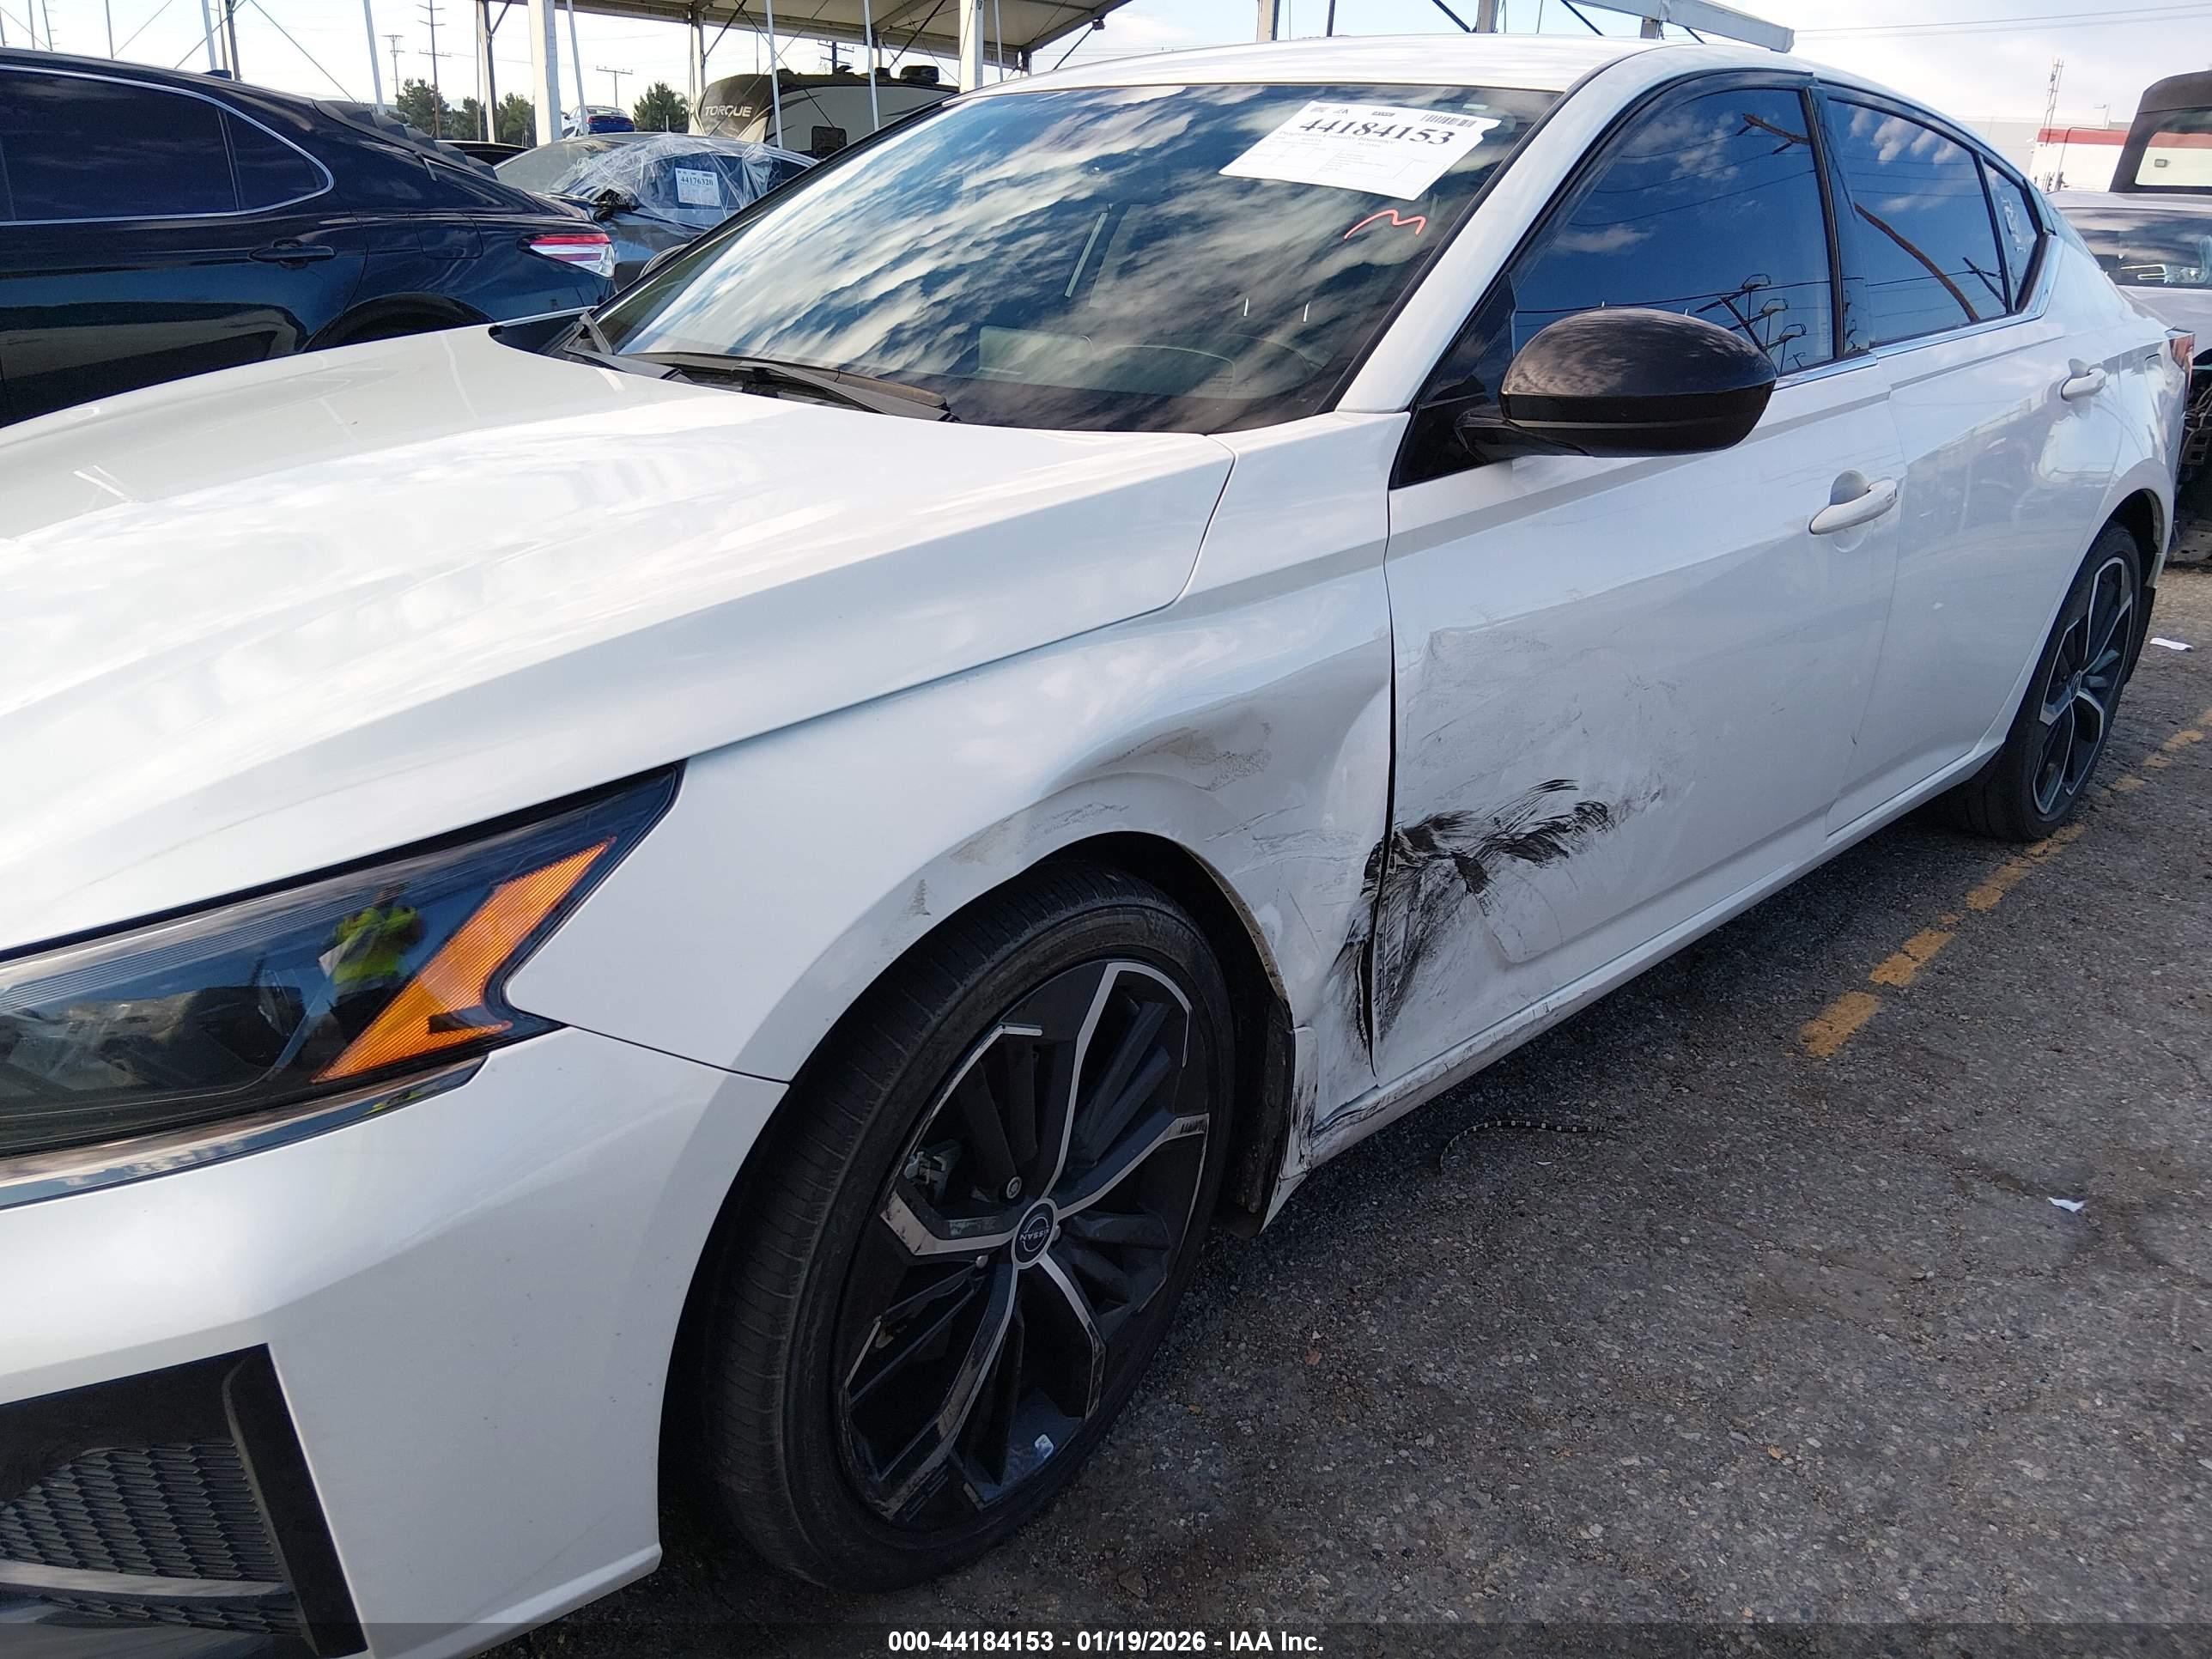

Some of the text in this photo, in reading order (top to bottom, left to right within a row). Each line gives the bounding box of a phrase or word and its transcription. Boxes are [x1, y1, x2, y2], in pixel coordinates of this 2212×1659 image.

[705, 105, 752, 118] TORQUE
[1299, 118, 1455, 144] 44184153
[1019, 1228, 1050, 1241] NISSAN
